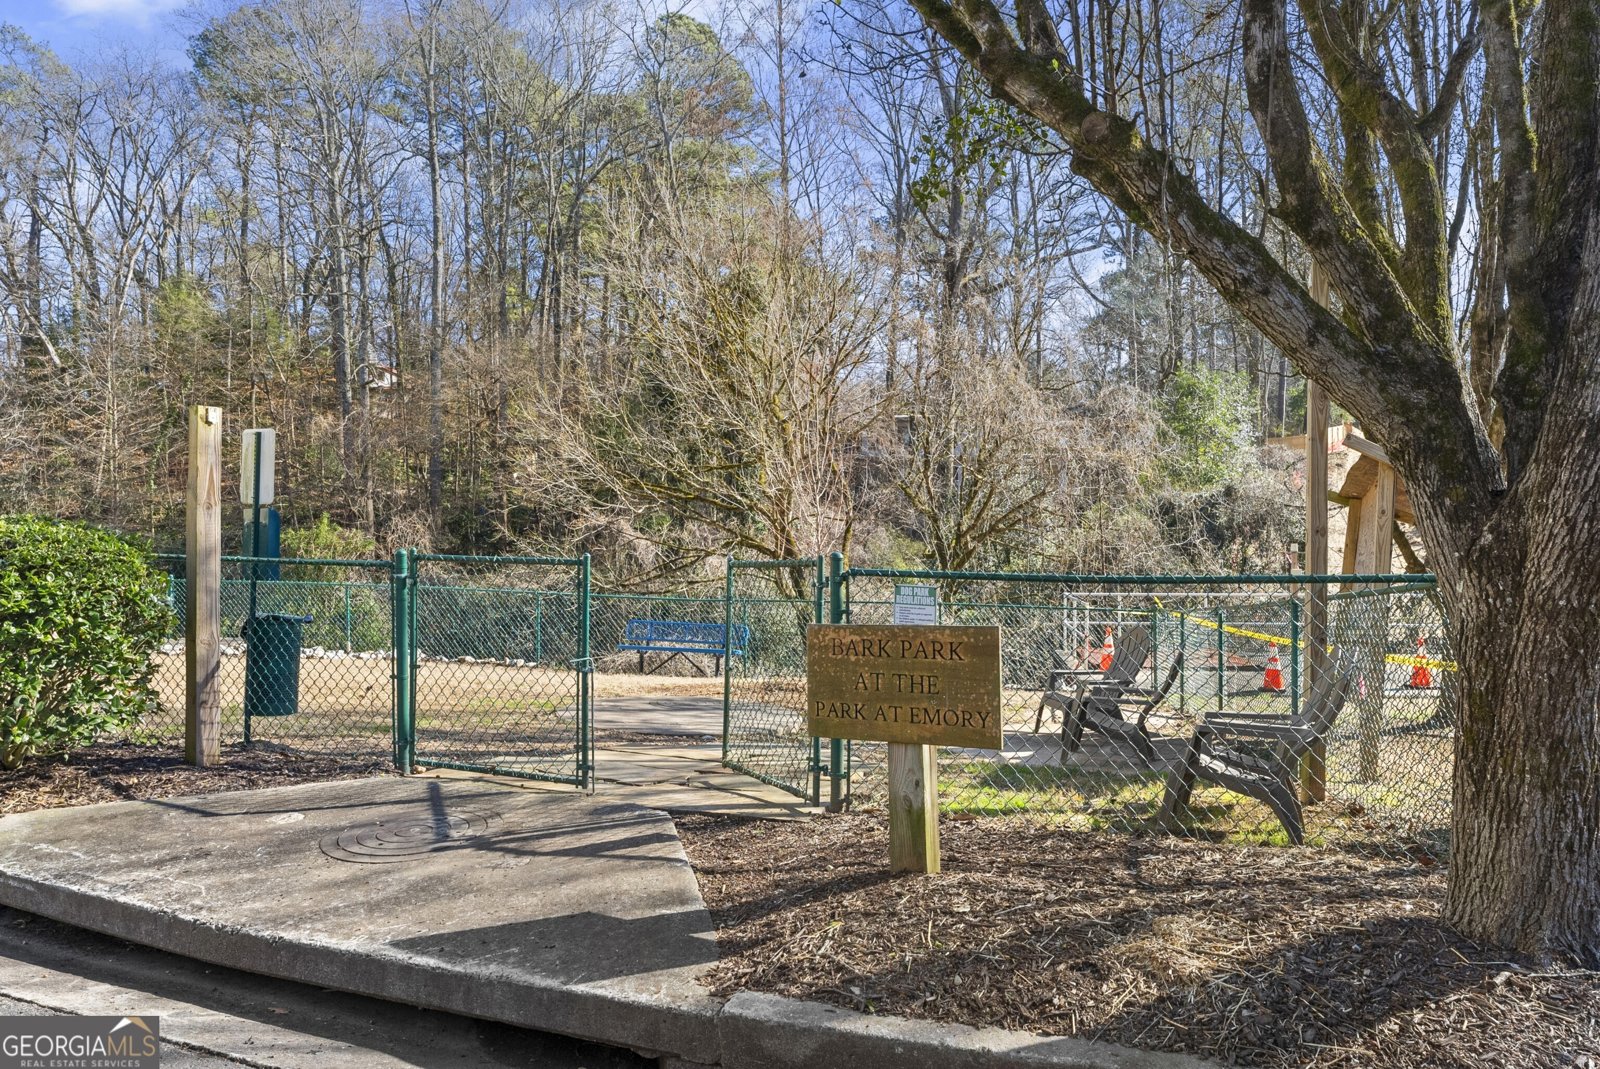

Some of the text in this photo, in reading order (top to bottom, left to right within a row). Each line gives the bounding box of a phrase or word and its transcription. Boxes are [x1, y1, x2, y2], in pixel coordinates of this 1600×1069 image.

[895, 595, 935, 605] REGULATIONS
[900, 586, 929, 596] DOG PARK
[831, 637, 965, 661] BARK PARK
[854, 672, 940, 695] AT THE
[815, 701, 992, 729] PARK AT EMORY
